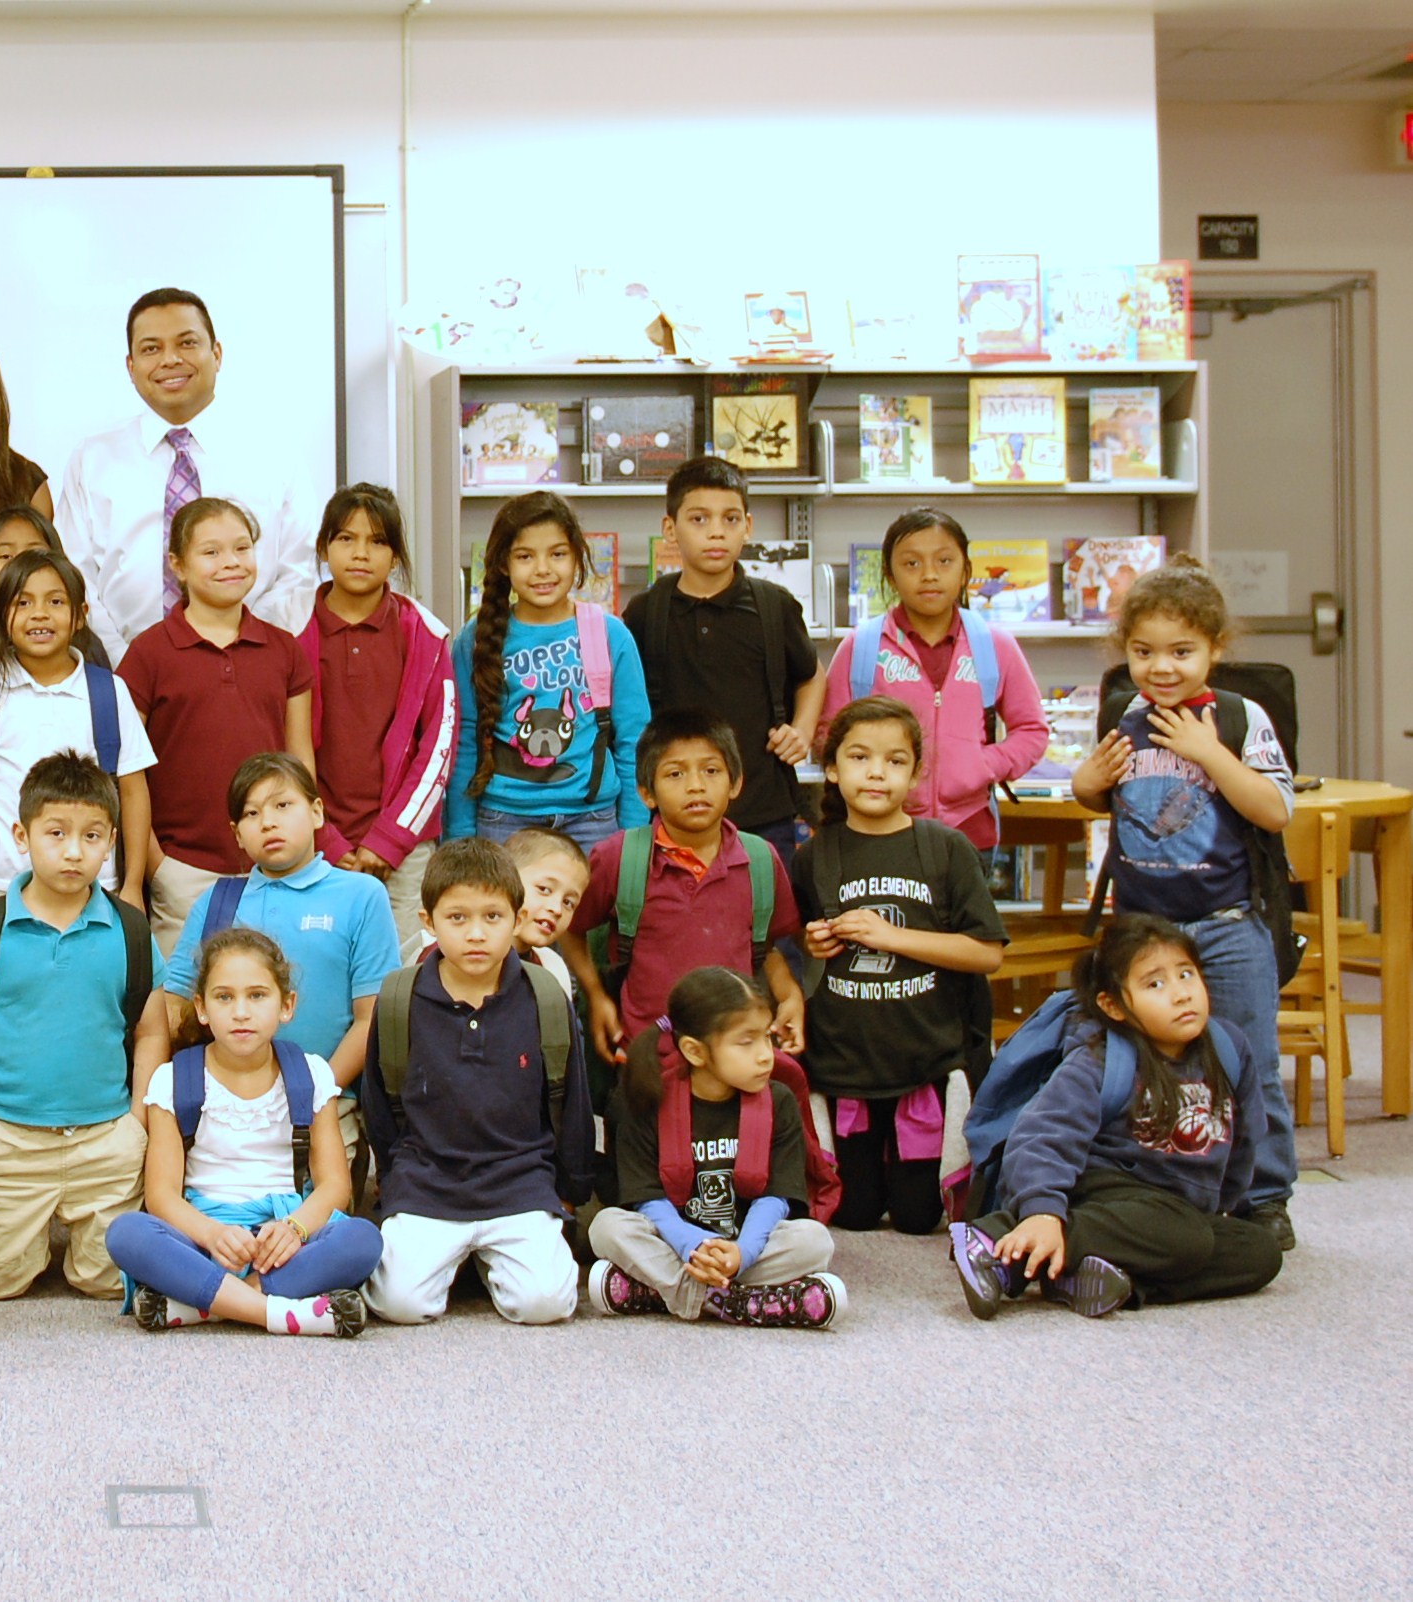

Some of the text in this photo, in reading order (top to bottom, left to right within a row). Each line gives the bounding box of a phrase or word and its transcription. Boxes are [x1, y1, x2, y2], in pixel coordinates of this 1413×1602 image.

[1200, 221, 1256, 237] CAPACITY
[988, 400, 1045, 417] MATH
[503, 637, 581, 680] PUPPY
[542, 666, 590, 691] LOV
[827, 972, 936, 1000] JOURNEY INTO THE FUTURE
